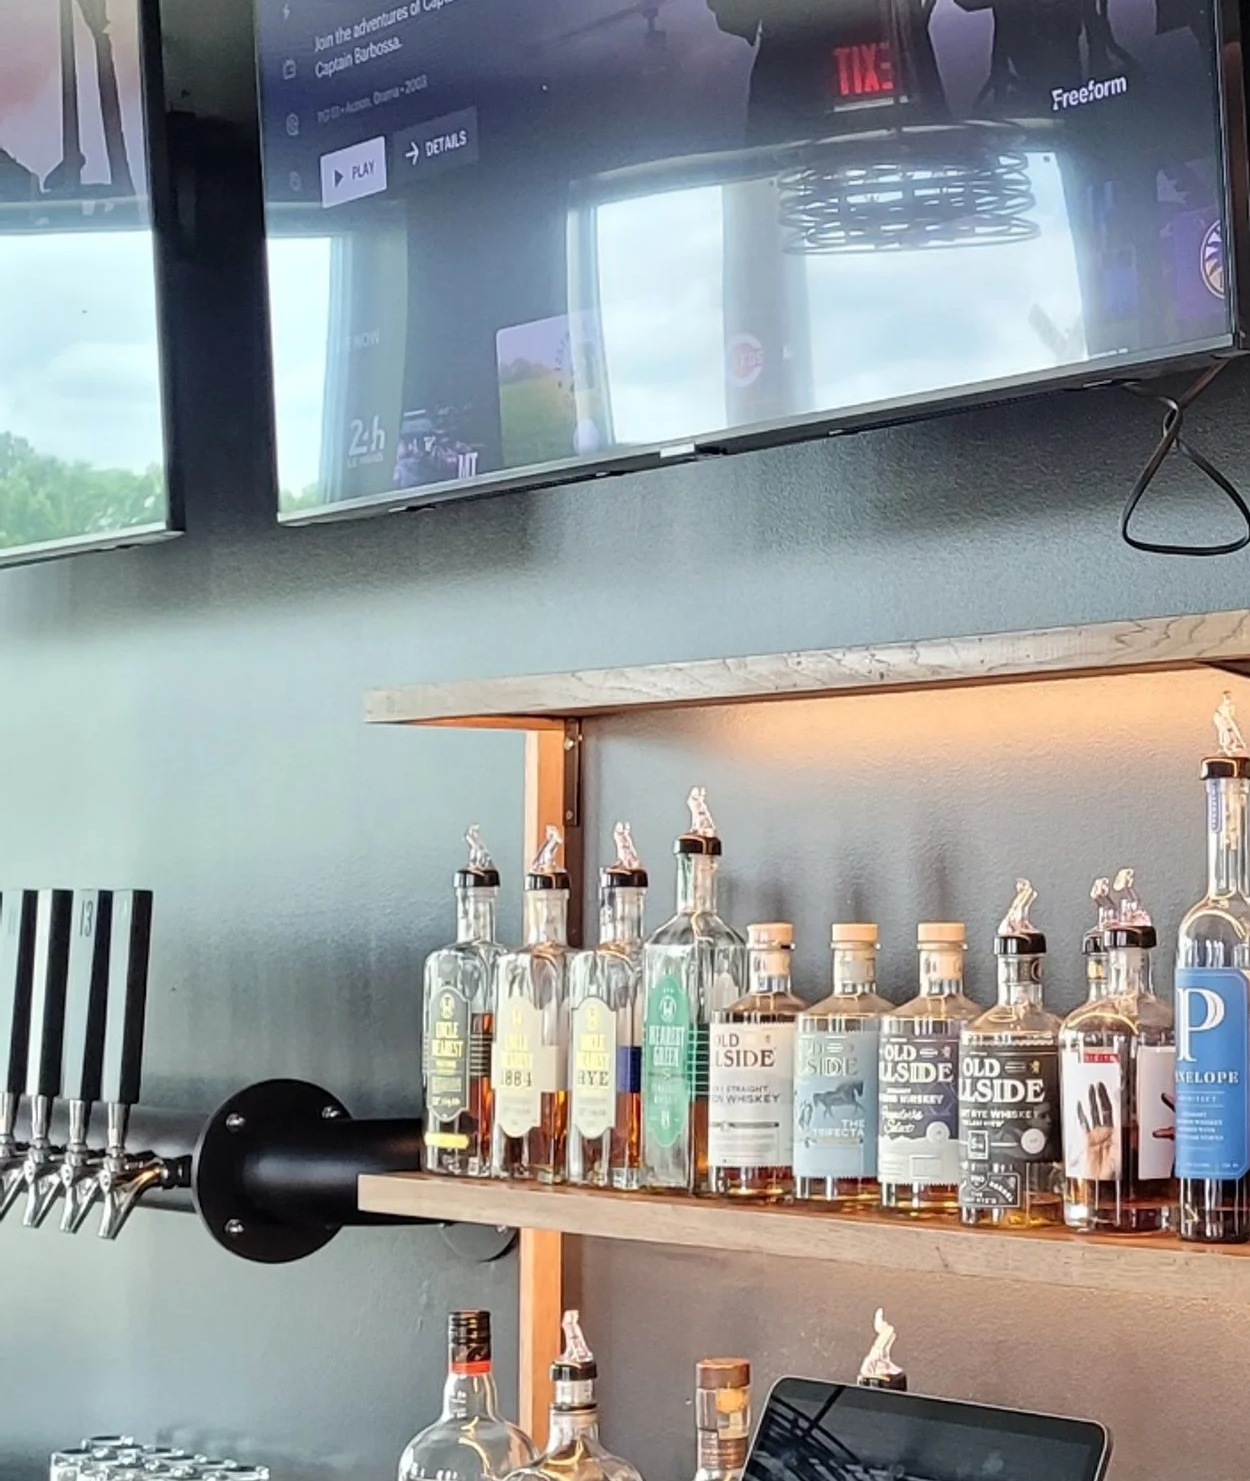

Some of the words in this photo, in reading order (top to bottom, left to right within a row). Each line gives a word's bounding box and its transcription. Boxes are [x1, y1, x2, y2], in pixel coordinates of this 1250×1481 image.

[314, 31, 333, 52] Join
[335, 25, 351, 44] the
[353, 6, 408, 38] adventures
[315, 50, 352, 78] Captain
[354, 36, 403, 65] Barbossa.
[1051, 76, 1127, 111] Freeform
[352, 160, 375, 181] PLAY
[426, 131, 467, 157] DETAILS
[1176, 987, 1225, 1062] P
[884, 1044, 917, 1061] OLD
[962, 1057, 1001, 1078] OLD
[726, 1093, 781, 1104] WHISKEY
[841, 1119, 865, 1128] THE
[990, 1109, 1040, 1119] WHISKEY
